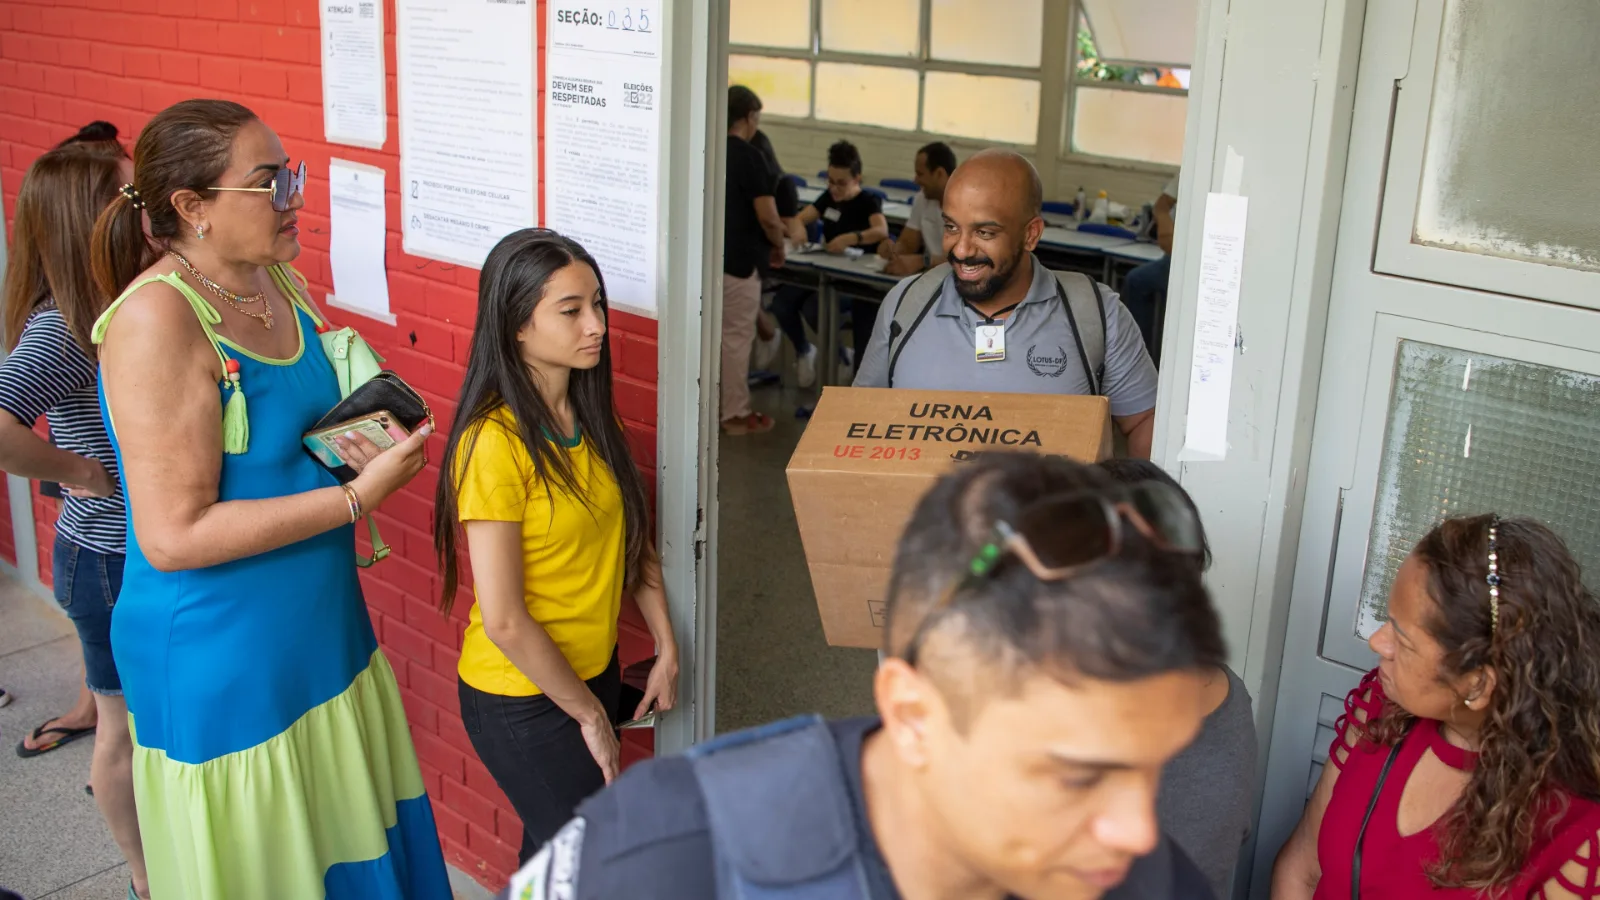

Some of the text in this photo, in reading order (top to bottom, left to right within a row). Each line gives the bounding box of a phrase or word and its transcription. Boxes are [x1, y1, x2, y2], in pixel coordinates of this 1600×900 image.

[557, 8, 603, 26] SEÇÃO:
[552, 80, 594, 94] DEVEM SER
[624, 83, 653, 93] ELEIÇÕES
[552, 92, 607, 108] RESPEITADAS
[462, 187, 486, 197] TELEFONE
[487, 191, 510, 200] CELULAR
[908, 402, 993, 421] URNA
[846, 423, 1042, 446] ELETRÔNICA
[833, 445, 921, 461] UE 2013
